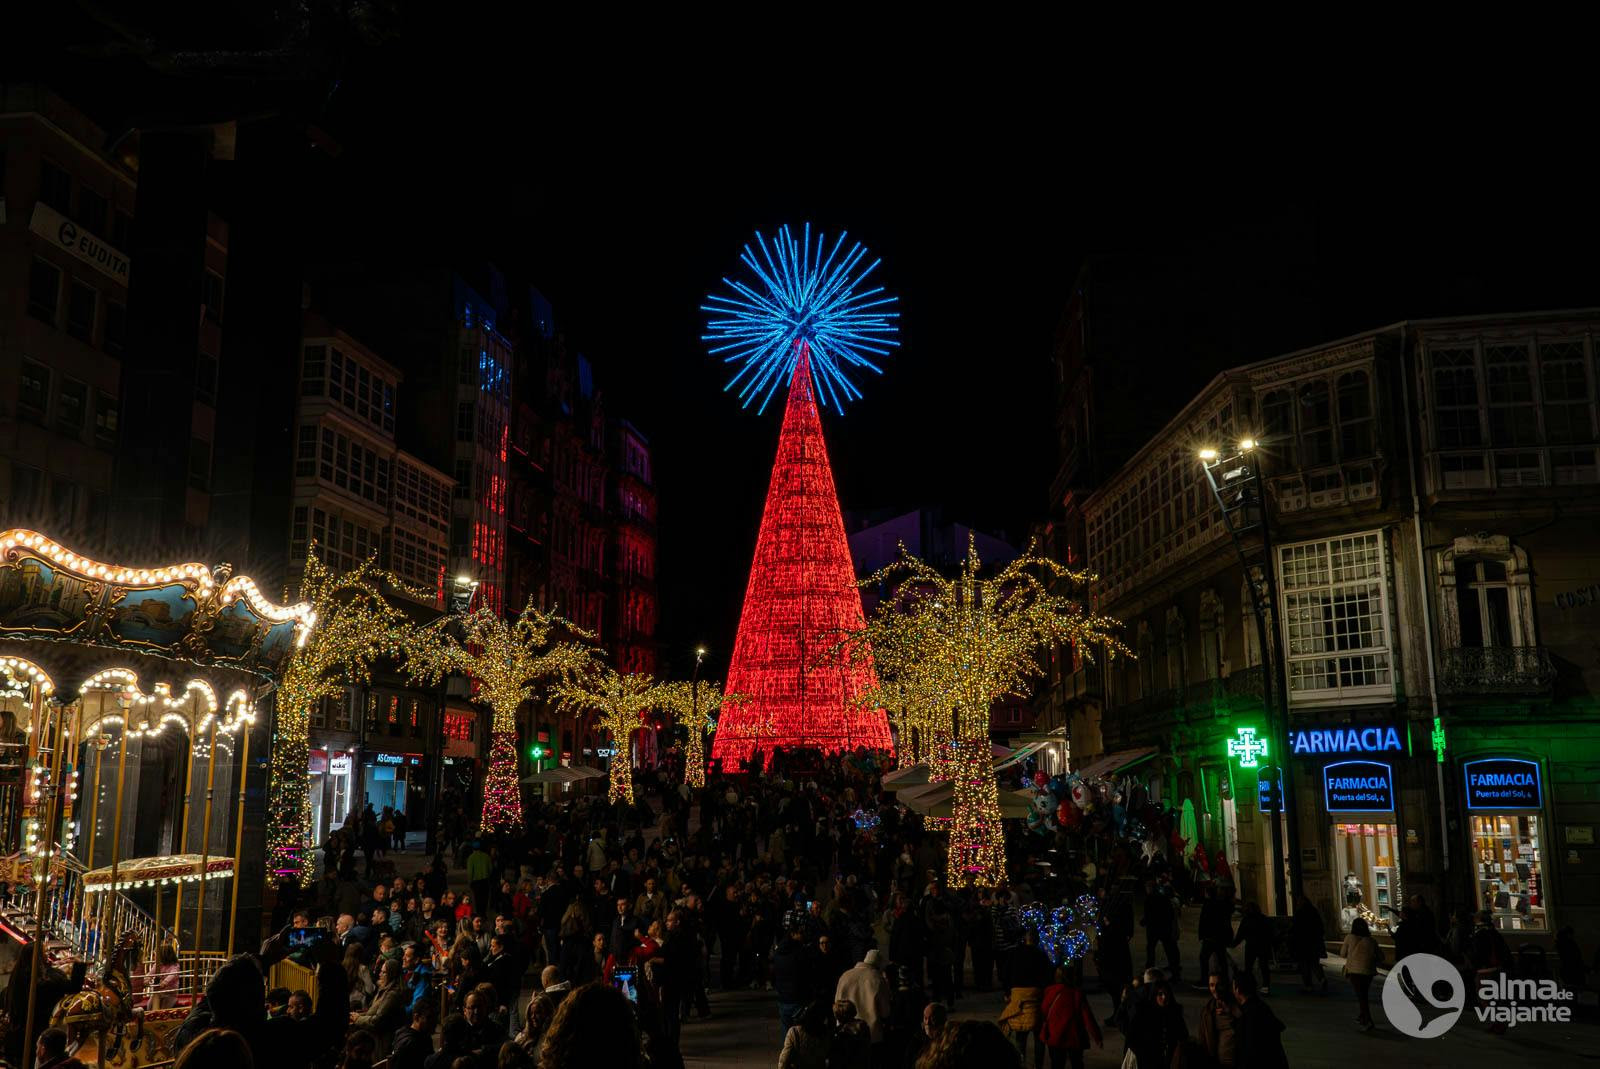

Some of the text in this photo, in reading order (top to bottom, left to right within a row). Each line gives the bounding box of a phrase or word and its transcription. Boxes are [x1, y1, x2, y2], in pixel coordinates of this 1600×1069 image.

[79, 237, 126, 275] EUDITA
[377, 753, 383, 763] AS
[1328, 776, 1388, 790] FARMACIA
[1470, 773, 1535, 786] FARMACIA
[1332, 793, 1355, 802] Puerta
[1355, 793, 1366, 801] del
[1366, 793, 1379, 803] Sol,
[1475, 790, 1500, 798] Puerta
[1500, 790, 1512, 798] del
[1512, 790, 1526, 799] Sol,
